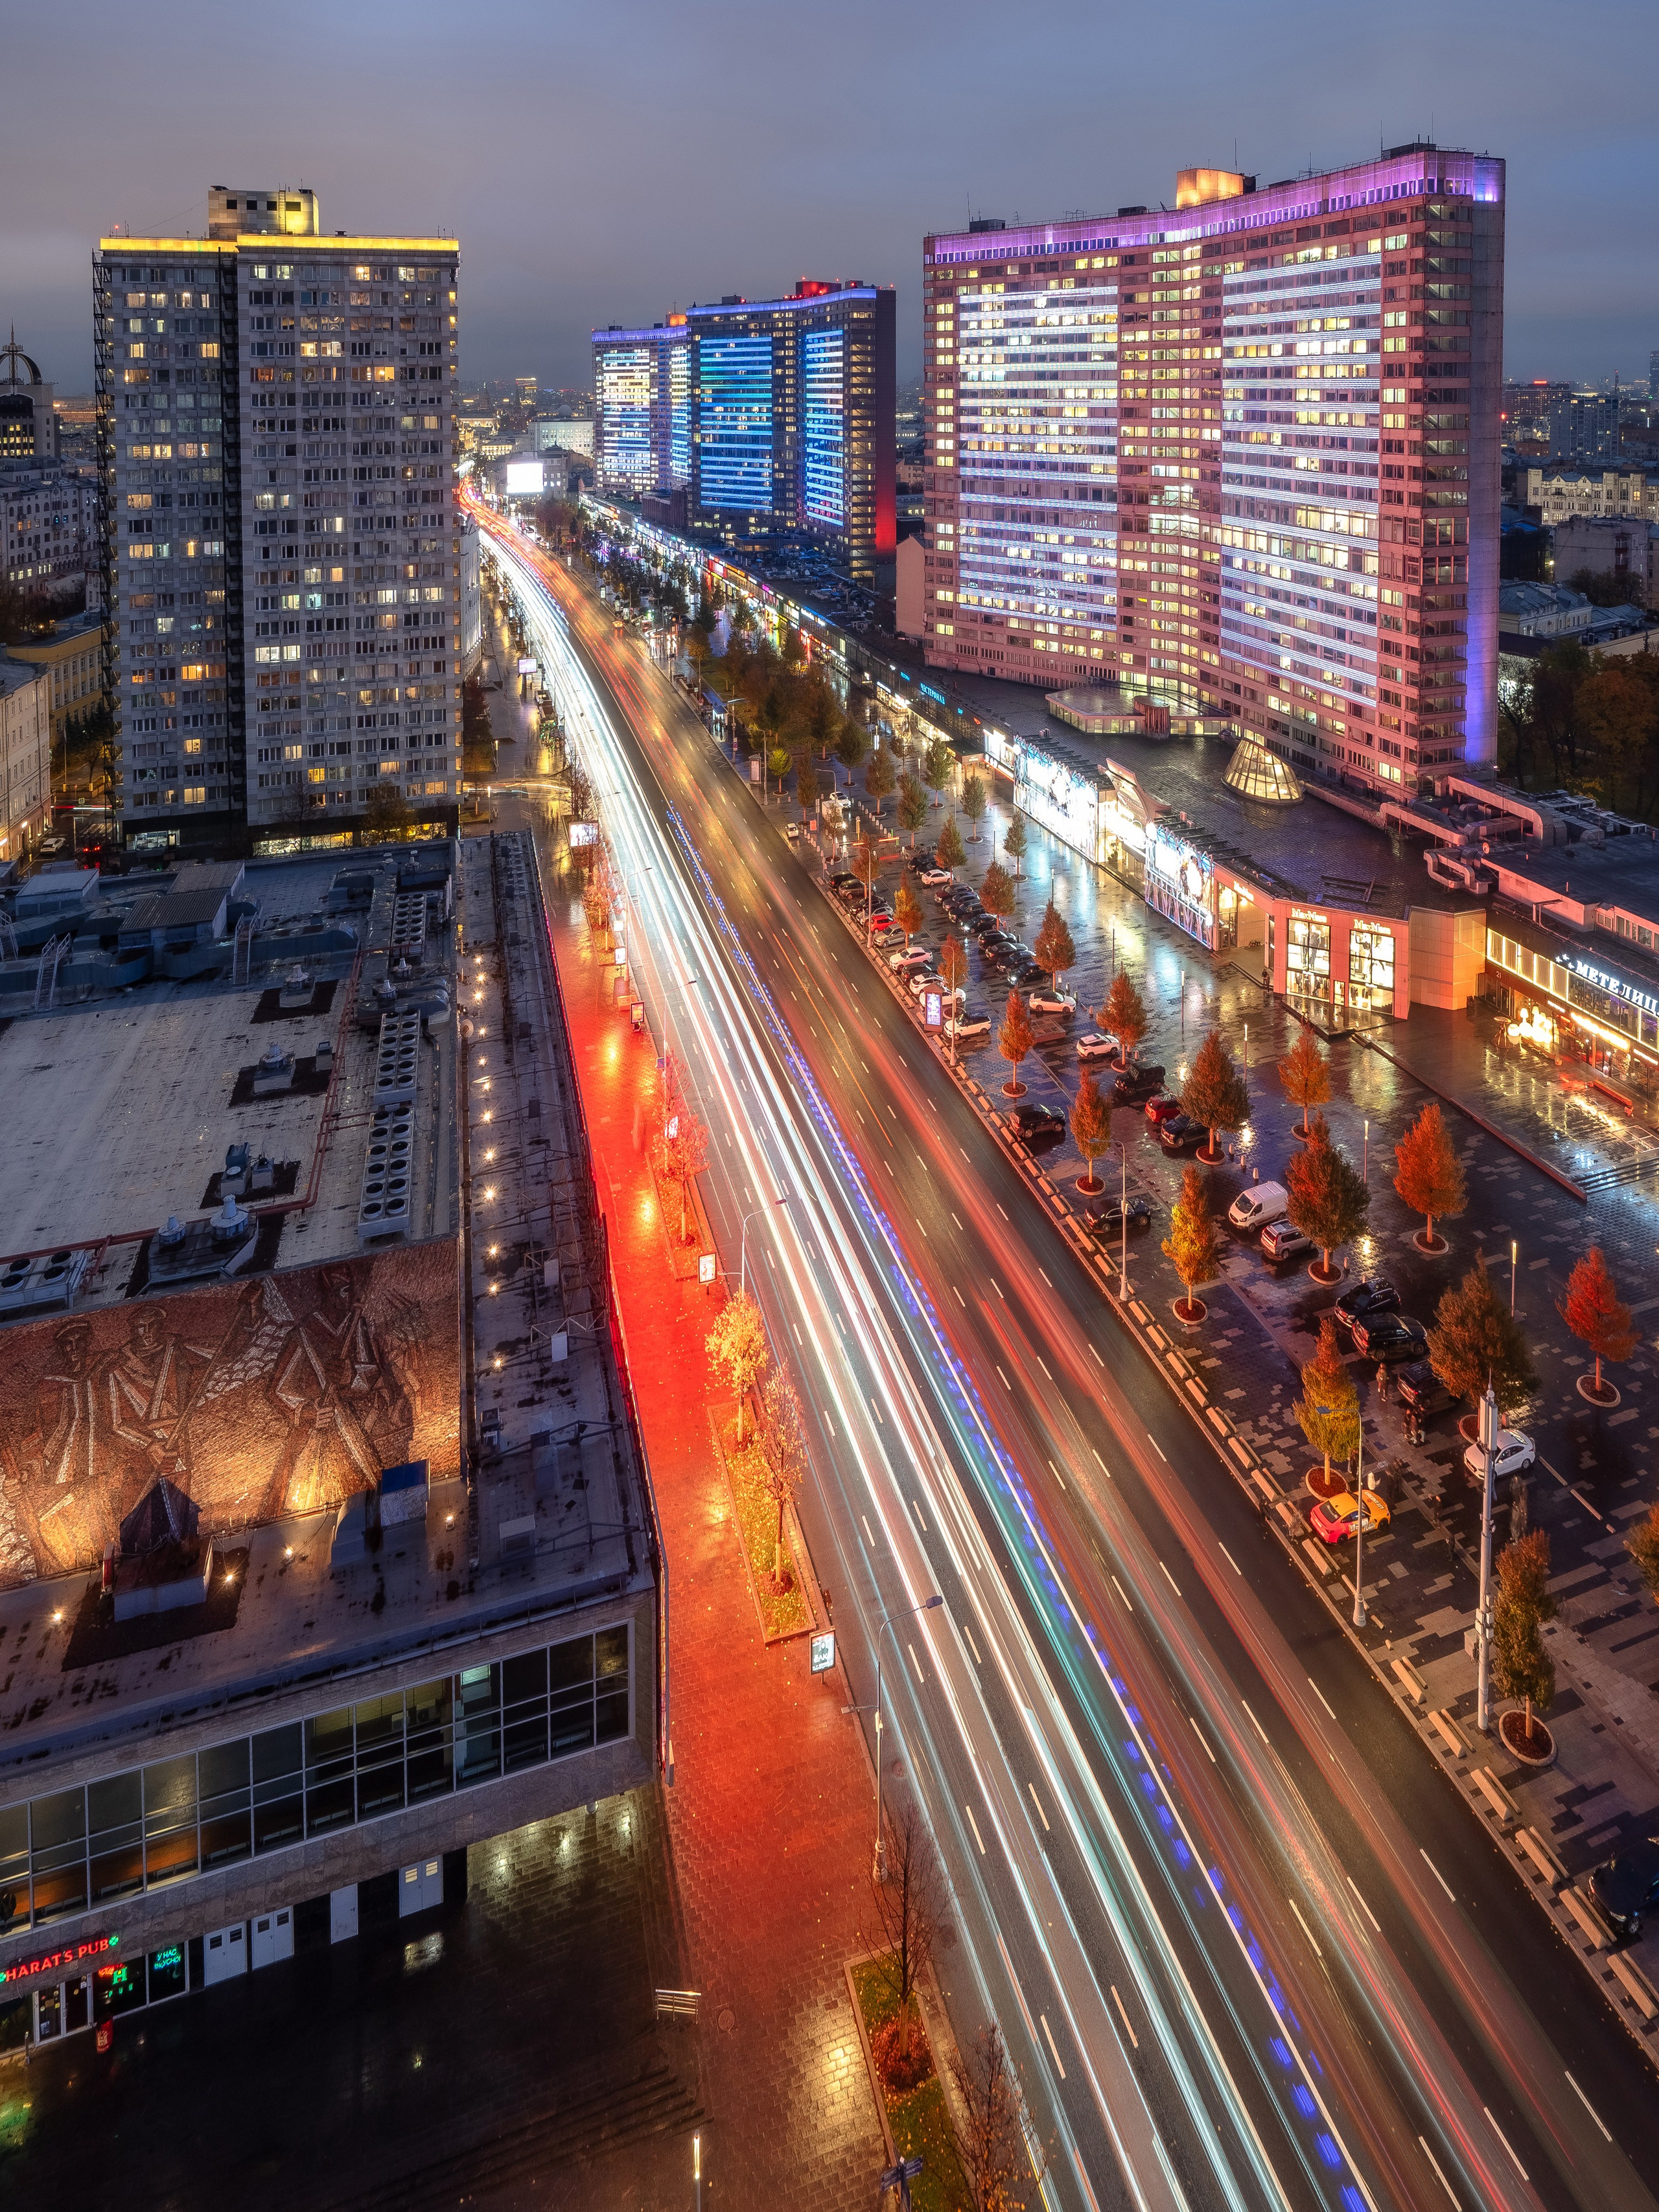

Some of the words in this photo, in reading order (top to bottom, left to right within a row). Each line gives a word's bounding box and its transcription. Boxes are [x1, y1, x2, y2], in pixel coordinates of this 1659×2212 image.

[1575, 960, 1659, 1016] МЕТЕЛИЦ
[5, 1949, 73, 1982] HARAT'S
[78, 1938, 110, 1959] PUB
[163, 1948, 177, 1959] НАС
